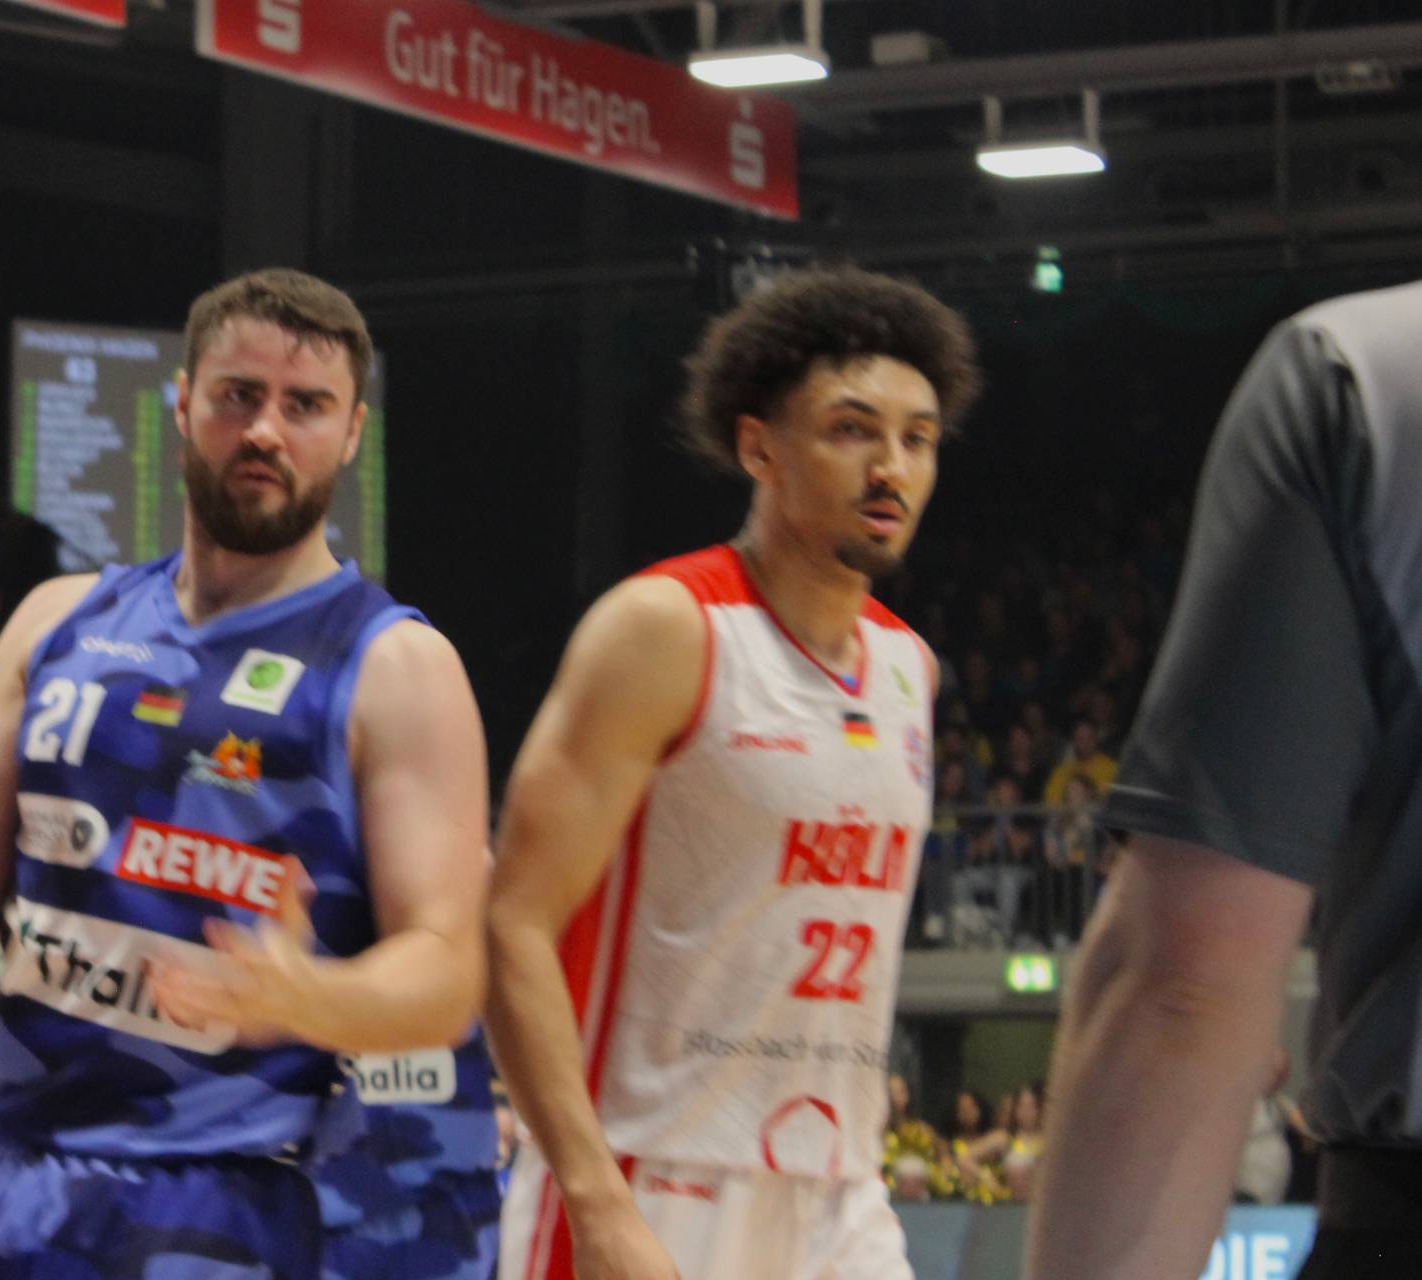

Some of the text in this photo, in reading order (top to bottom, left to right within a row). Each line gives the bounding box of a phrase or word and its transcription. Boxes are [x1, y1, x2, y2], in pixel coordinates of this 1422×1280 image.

[385, 9, 661, 155] Gut für Hagen.
[24, 677, 108, 767] 21
[124, 826, 286, 908] REWE
[35, 933, 159, 1021] Thal
[790, 919, 874, 1001] 22
[357, 1056, 440, 1093] alia
